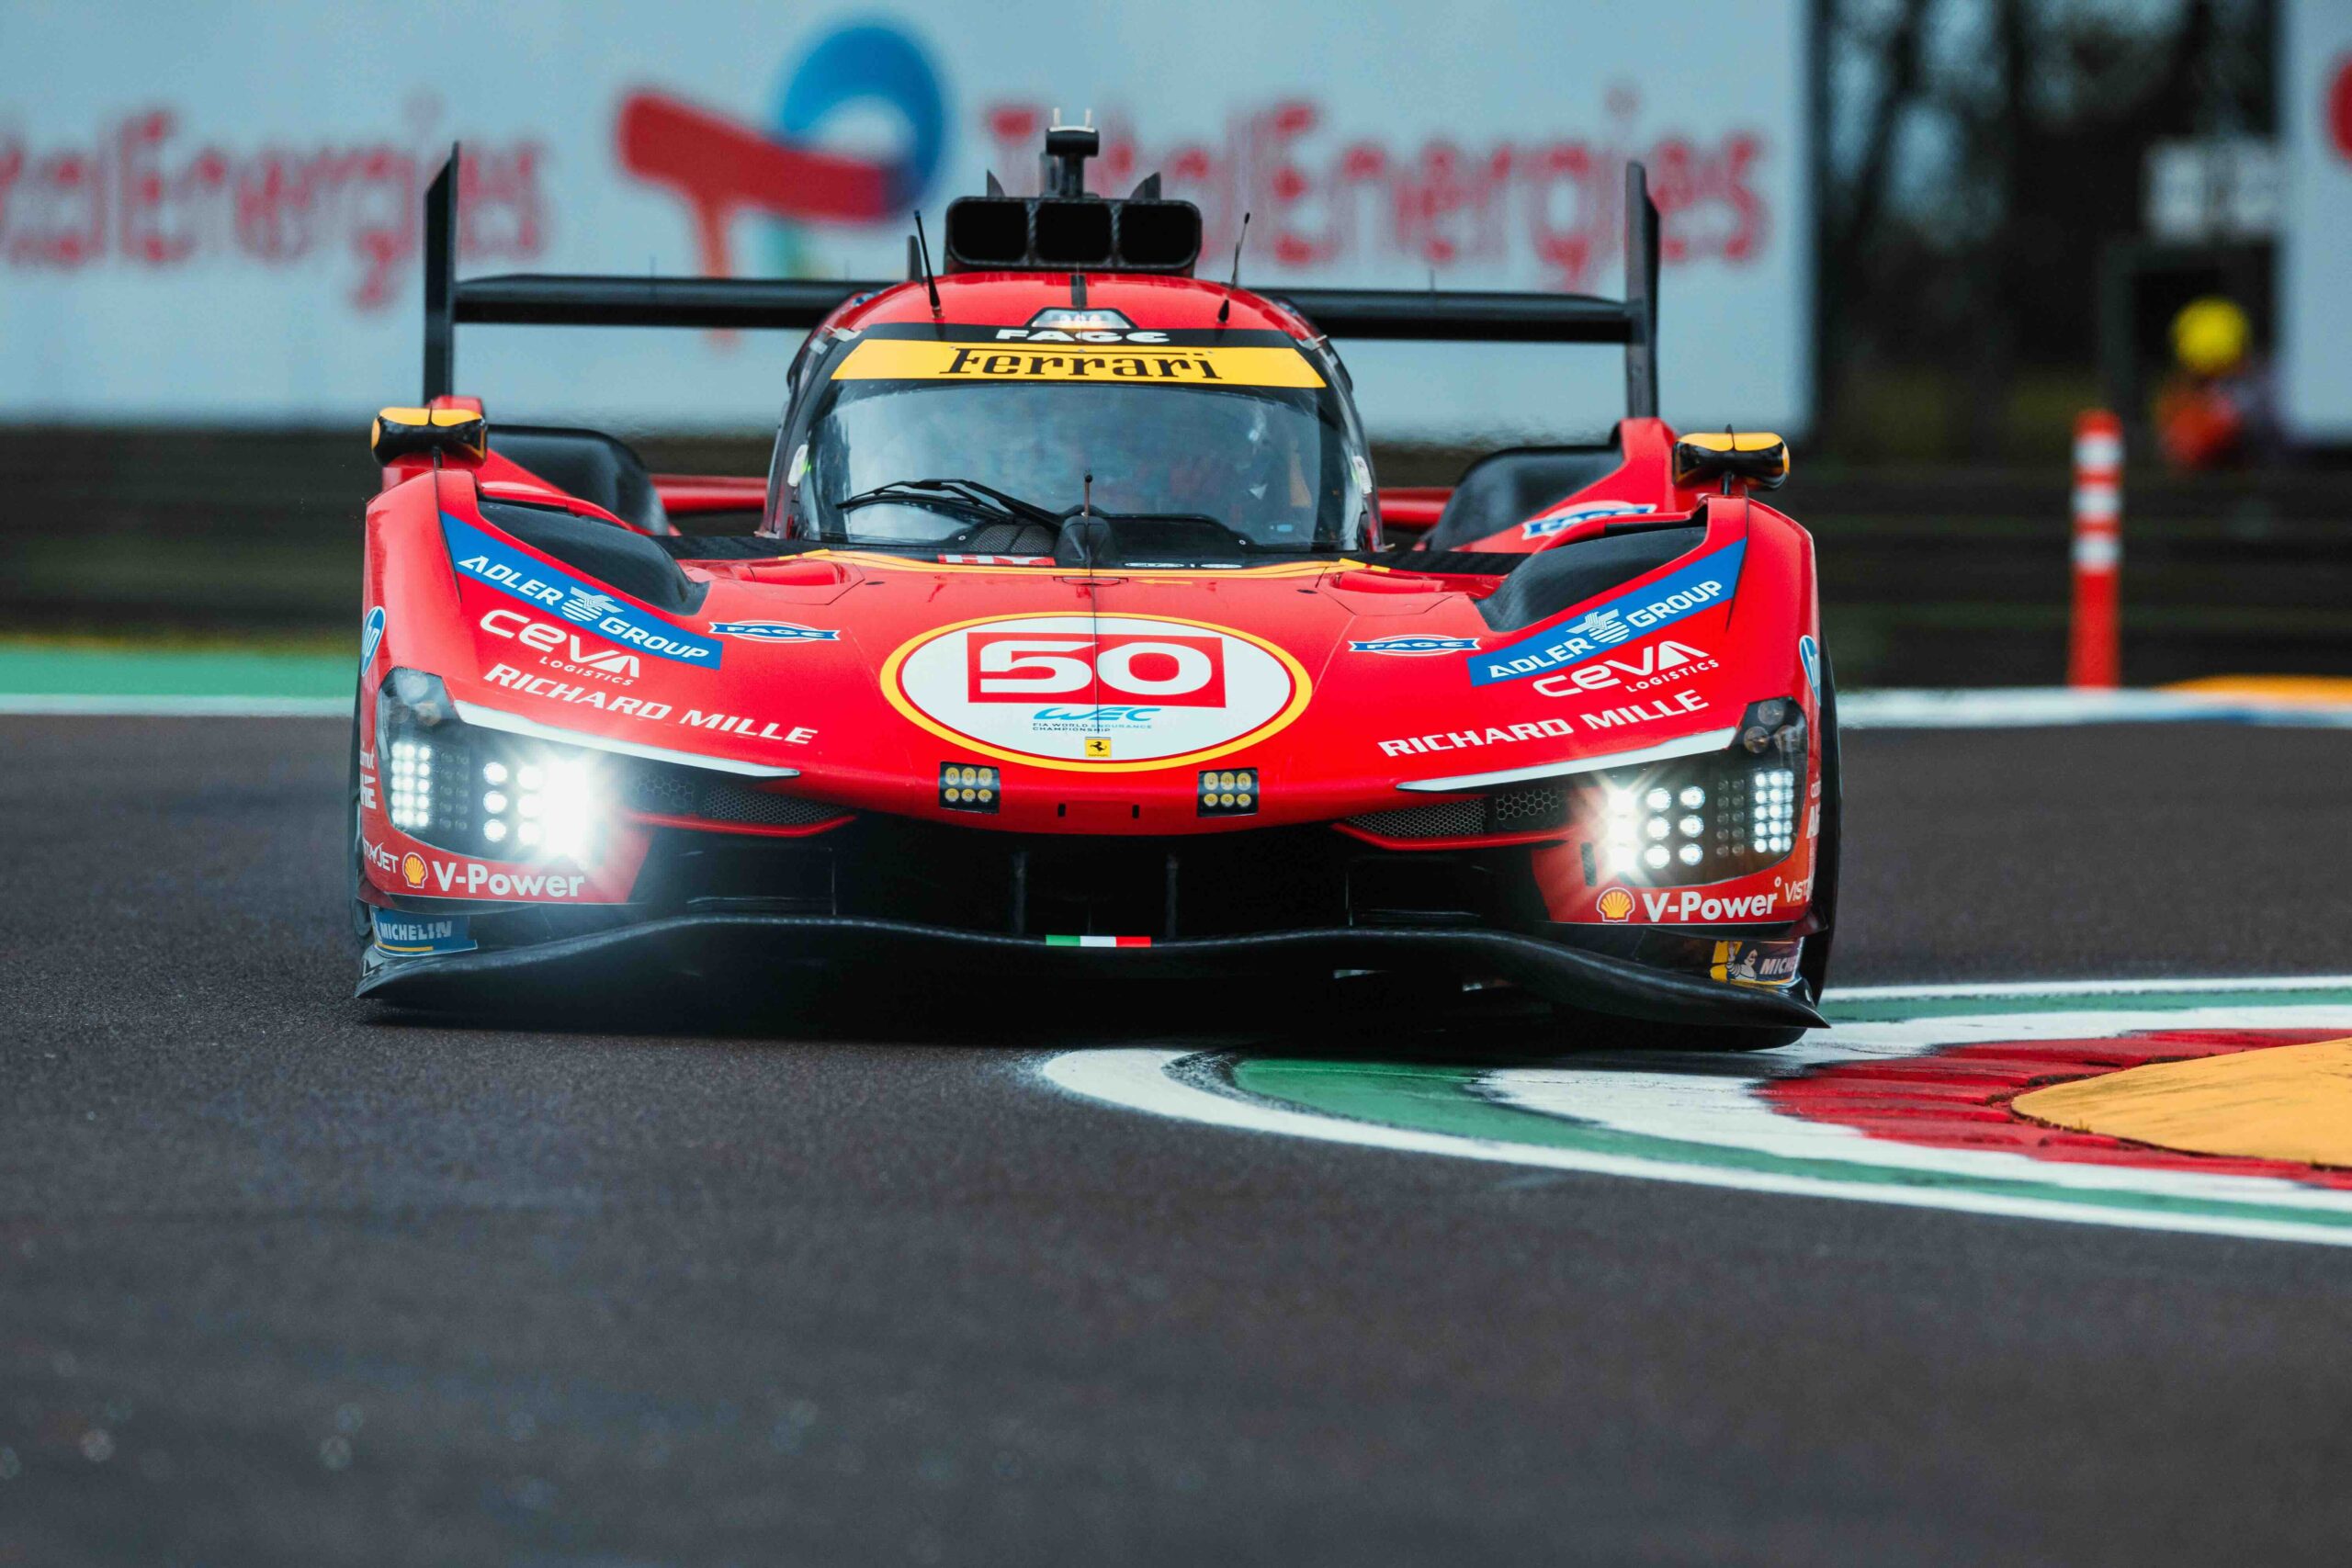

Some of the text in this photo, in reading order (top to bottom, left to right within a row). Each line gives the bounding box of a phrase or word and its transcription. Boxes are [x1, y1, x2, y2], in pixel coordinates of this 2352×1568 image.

[995, 329, 1170, 343] FAGE
[939, 347, 1224, 379] Ferrari
[458, 556, 709, 660] ADLER GROUP
[1488, 580, 1723, 679] ADLER GROUP
[539, 656, 634, 686] LOGISTICS
[980, 640, 1212, 696] 50
[1625, 659, 1720, 693] LOGISTICS
[483, 662, 819, 745] RICHARD MILLE
[1034, 706, 1161, 721] WEC
[1378, 690, 1710, 757] RICHARD MILLE
[432, 861, 585, 897] V-Power
[1641, 891, 1778, 922] V-Power
[379, 920, 452, 941] MICHELIN
